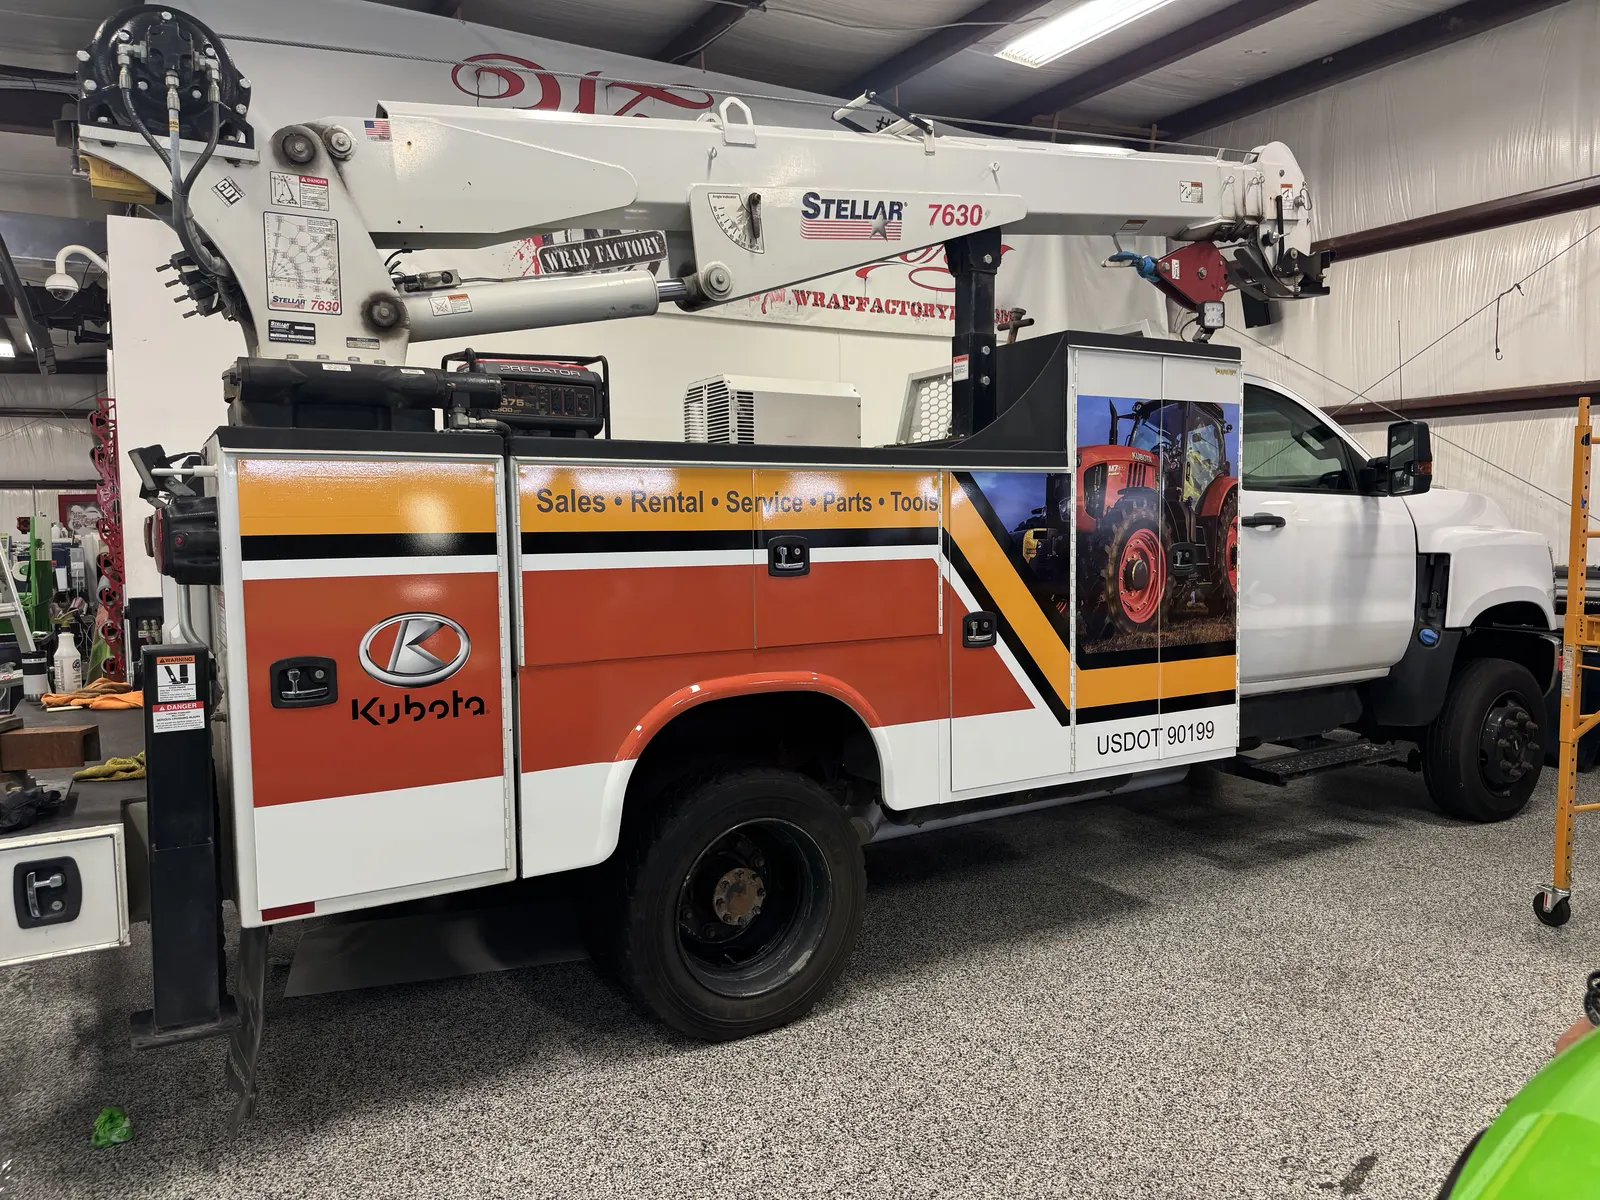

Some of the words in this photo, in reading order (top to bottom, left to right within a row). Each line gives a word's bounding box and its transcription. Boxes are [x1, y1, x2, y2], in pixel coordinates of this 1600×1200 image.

[216, 179, 242, 204] CDT
[801, 191, 903, 220] STELLAR
[928, 204, 983, 226] 7630
[544, 247, 591, 271] WRAP
[595, 236, 661, 263] FACTORY
[272, 295, 306, 305] STELLAR
[310, 300, 340, 312] 7630
[500, 365, 581, 377] PREDATOR
[500, 398, 525, 407] 375
[1131, 451, 1153, 464] KUBOTA
[536, 488, 606, 513] Sales
[631, 489, 704, 513] Rental
[726, 490, 802, 513] Service
[823, 491, 873, 513] Parts
[890, 491, 939, 512] Tools
[167, 703, 197, 711] DANGER
[351, 690, 485, 726] Kubota
[1097, 728, 1163, 755] USDOT
[1167, 720, 1215, 745] 90199
